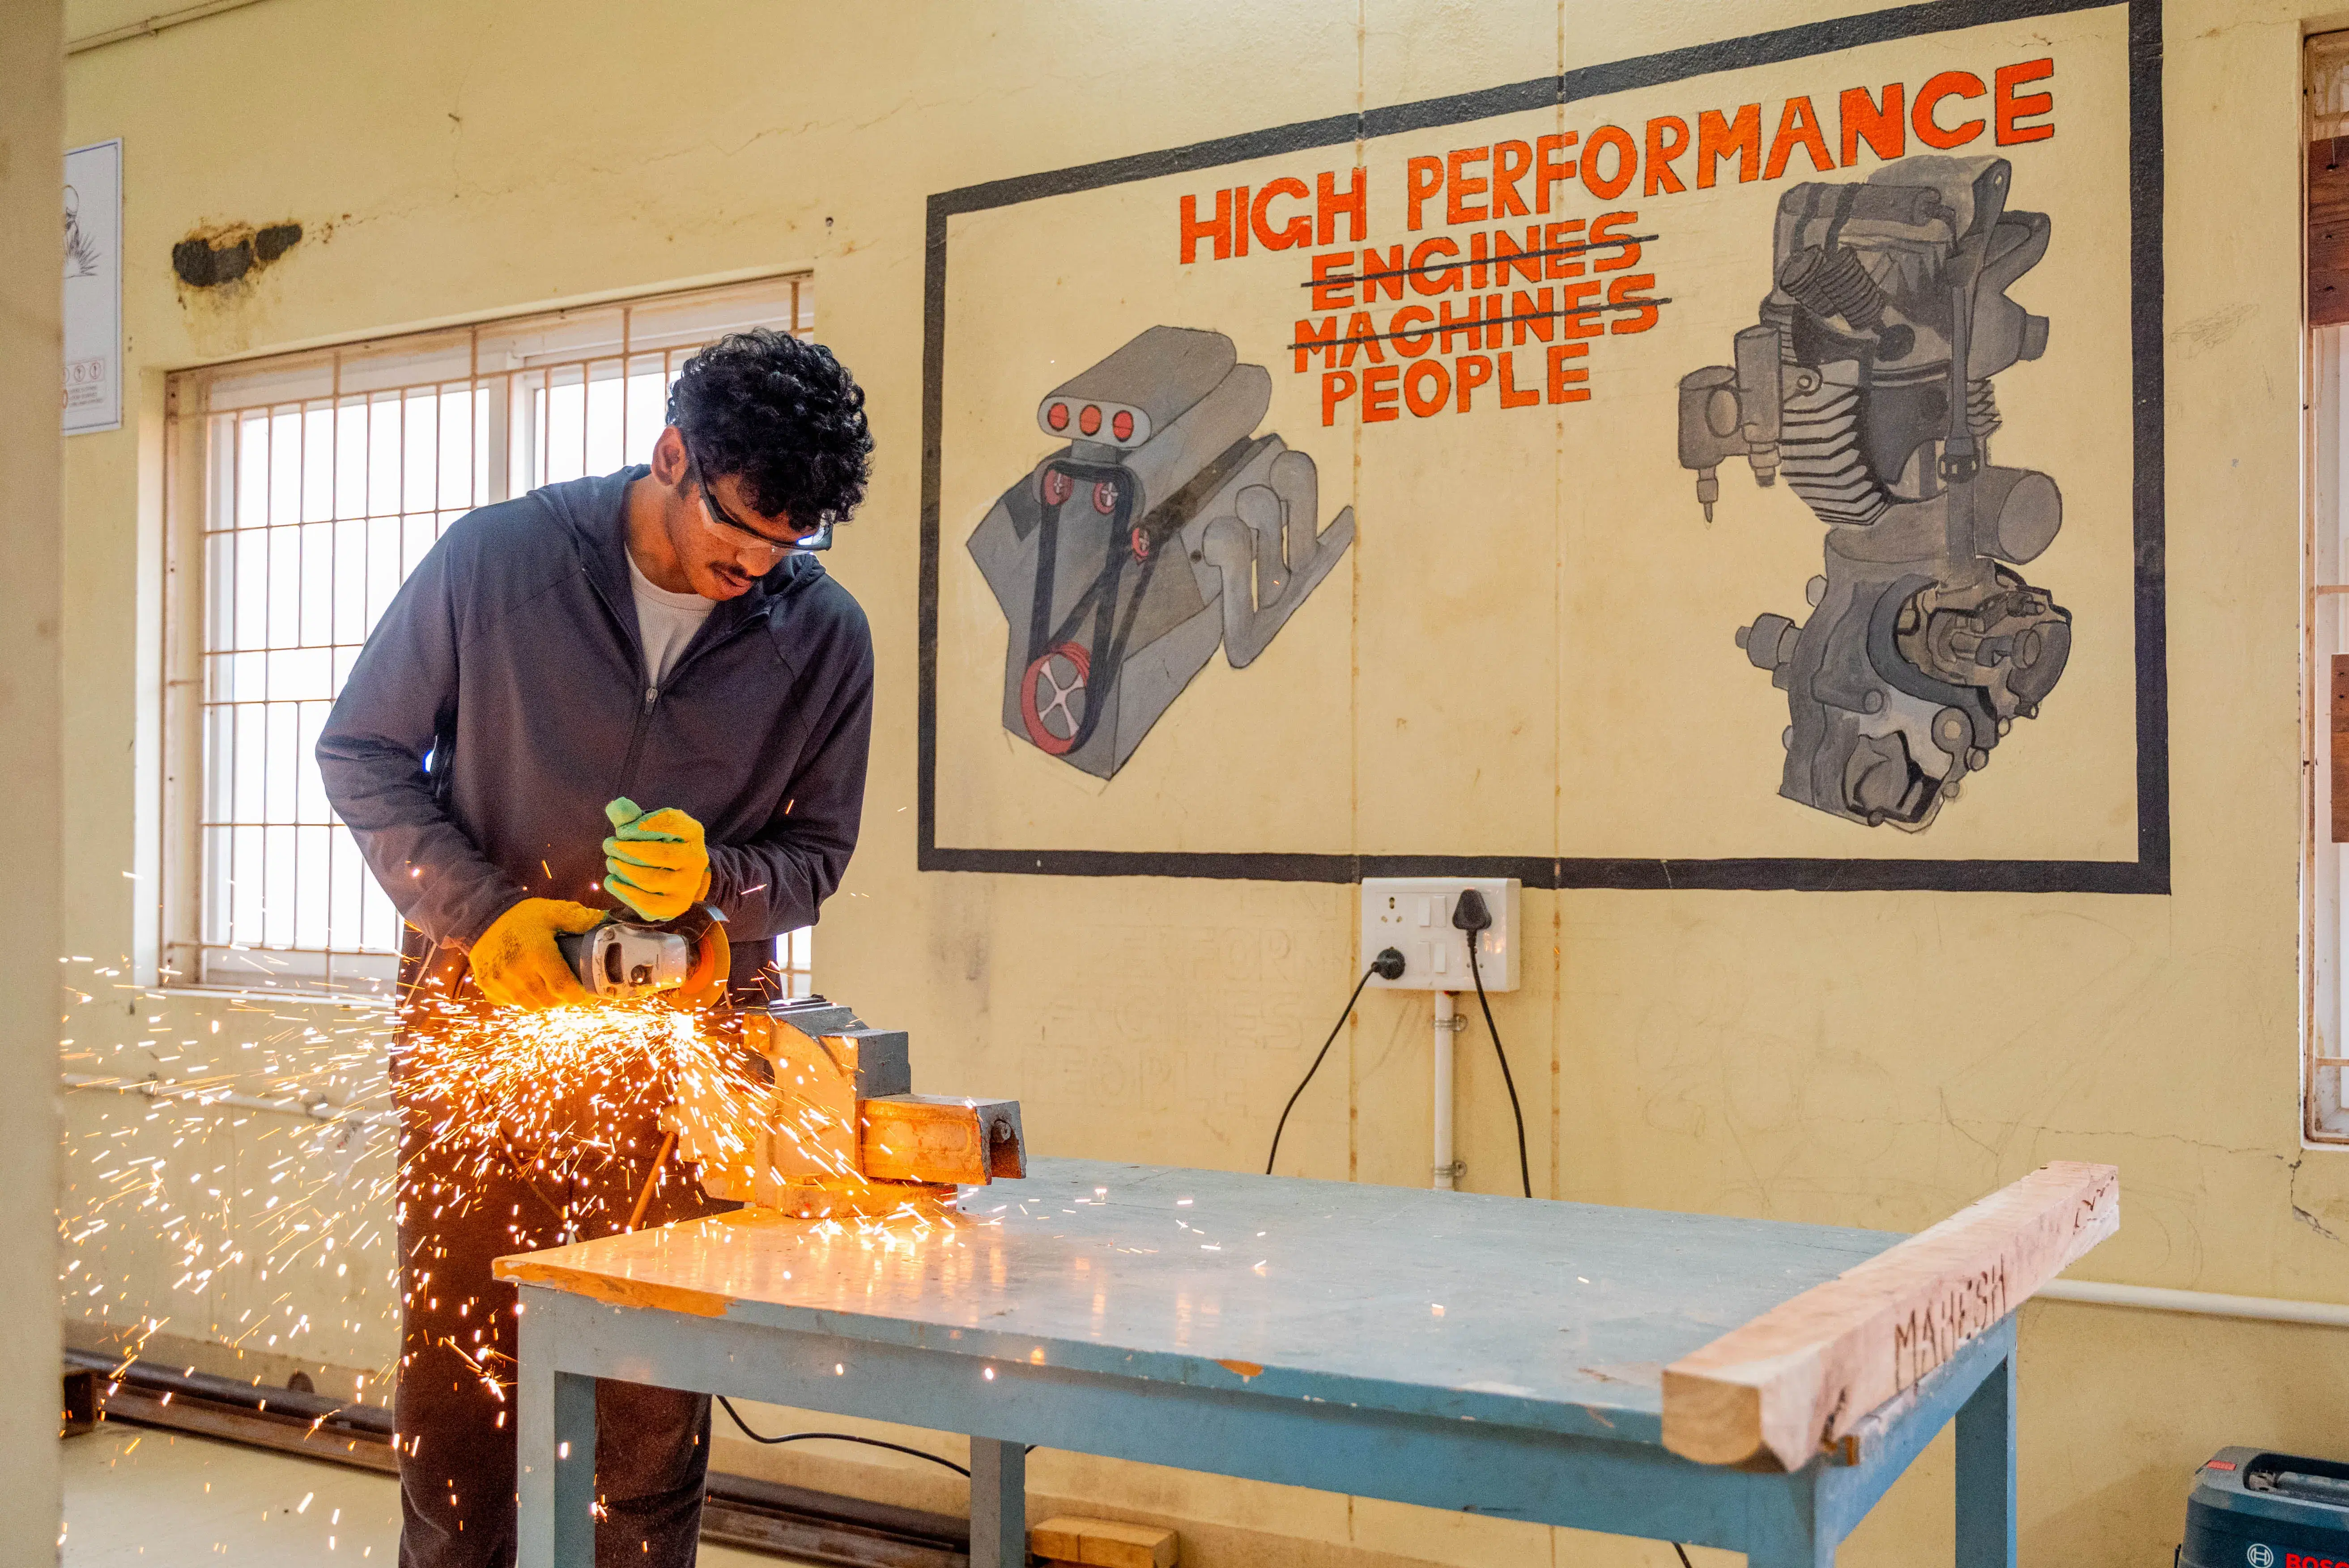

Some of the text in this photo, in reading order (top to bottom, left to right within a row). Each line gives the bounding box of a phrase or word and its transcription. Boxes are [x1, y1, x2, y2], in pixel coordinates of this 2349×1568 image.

[1180, 59, 2054, 265] HIGH PERFORMANCE
[1311, 212, 1642, 311] ENGINES
[1294, 274, 1660, 373] MACHINES
[1321, 343, 1591, 426] PEOPLE
